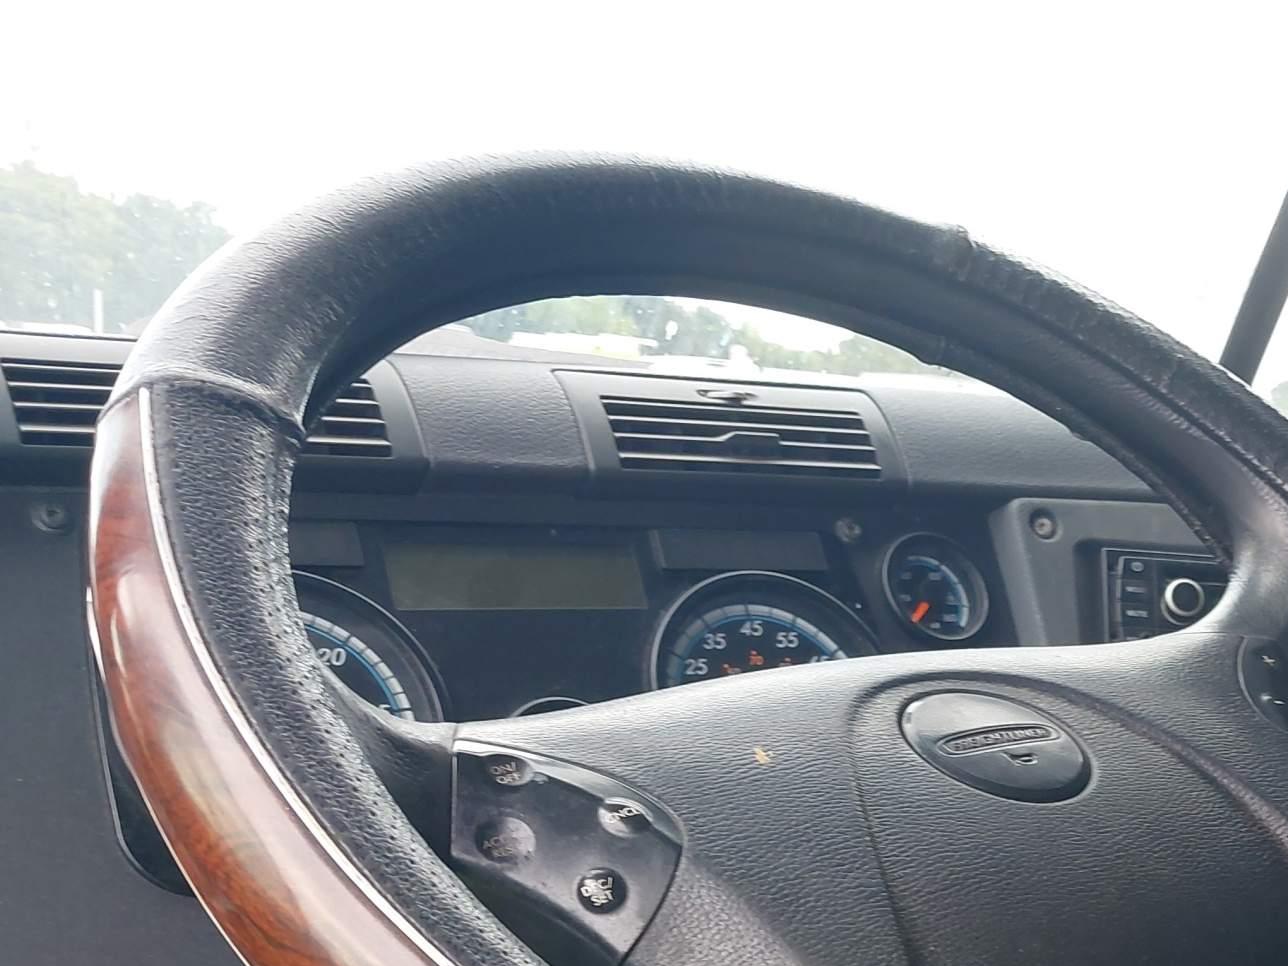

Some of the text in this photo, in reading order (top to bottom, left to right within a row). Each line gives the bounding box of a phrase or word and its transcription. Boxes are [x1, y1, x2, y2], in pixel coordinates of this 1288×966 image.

[740, 620, 763, 636] 45
[703, 633, 727, 650] 35
[775, 632, 799, 648] 55
[317, 648, 347, 667] 20
[685, 658, 709, 675] 25
